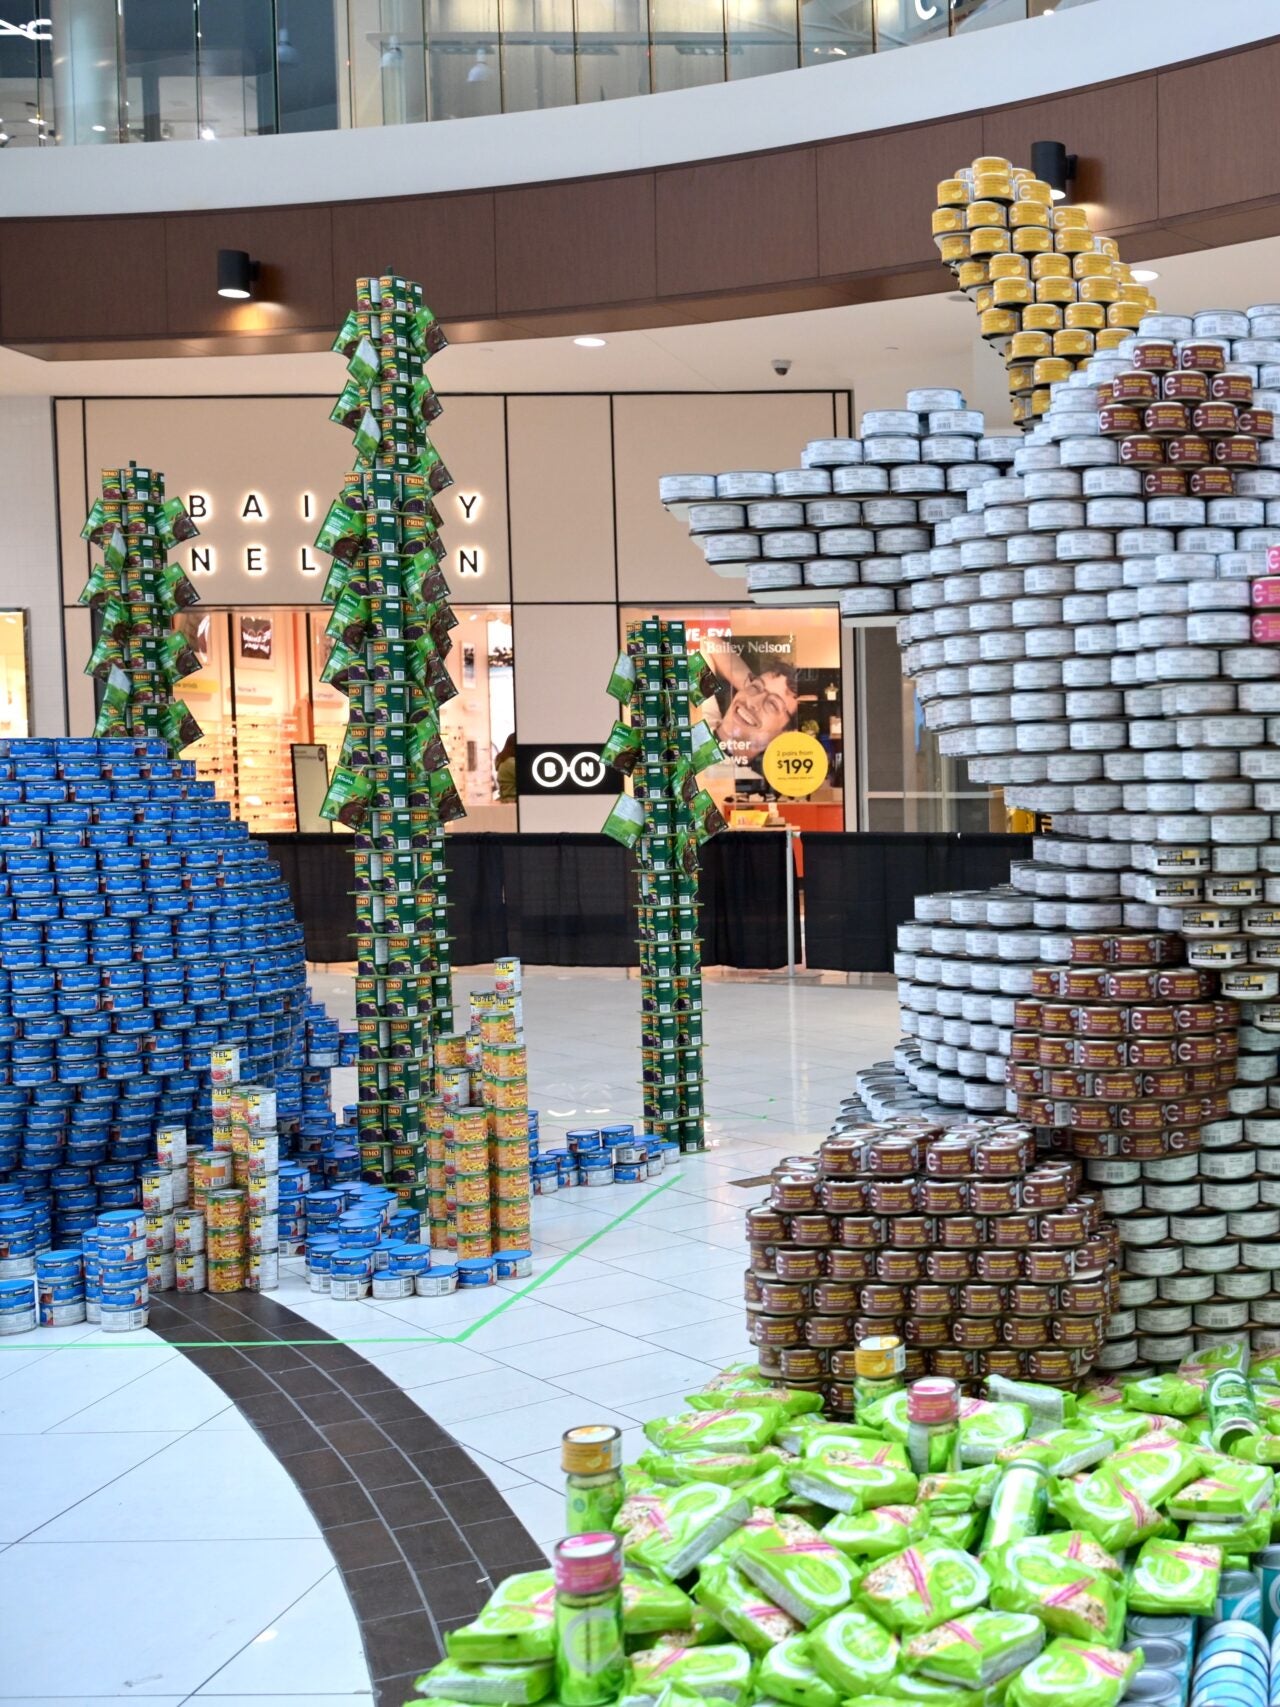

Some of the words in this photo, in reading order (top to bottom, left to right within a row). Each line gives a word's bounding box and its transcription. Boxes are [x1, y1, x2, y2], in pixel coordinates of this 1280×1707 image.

[188, 494, 477, 519] BAIY
[191, 547, 478, 573] NELN
[706, 641, 745, 656] Bailey
[748, 640, 791, 654] Nelson
[718, 740, 752, 750] etter
[777, 758, 814, 775] $199
